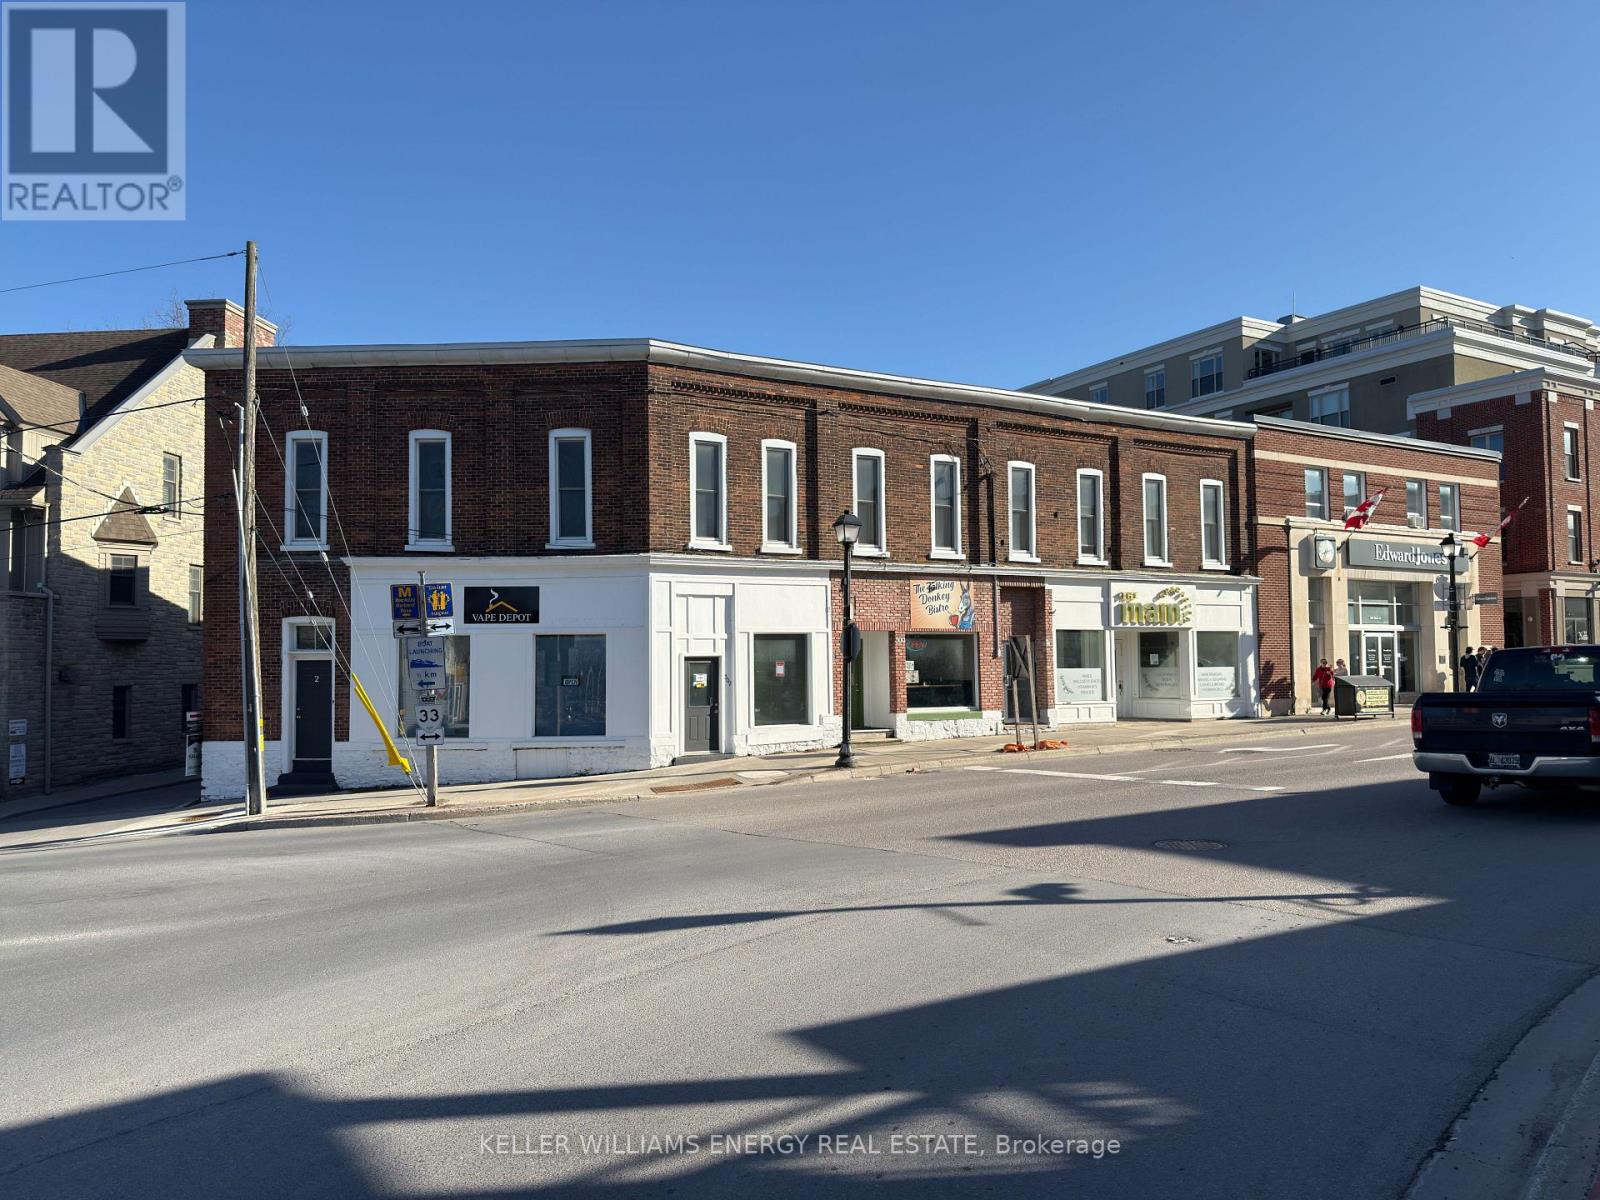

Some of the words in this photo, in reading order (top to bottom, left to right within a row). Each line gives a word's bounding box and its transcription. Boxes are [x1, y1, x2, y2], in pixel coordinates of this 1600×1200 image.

[398, 587, 411, 597] M
[913, 584, 925, 594] The
[926, 580, 955, 593] Talking
[919, 593, 950, 605] Donkey
[925, 604, 949, 615] Bistro
[472, 614, 496, 622] VAPE
[499, 614, 531, 622] DEPOT
[314, 675, 320, 683] 2
[419, 709, 439, 722] 33
